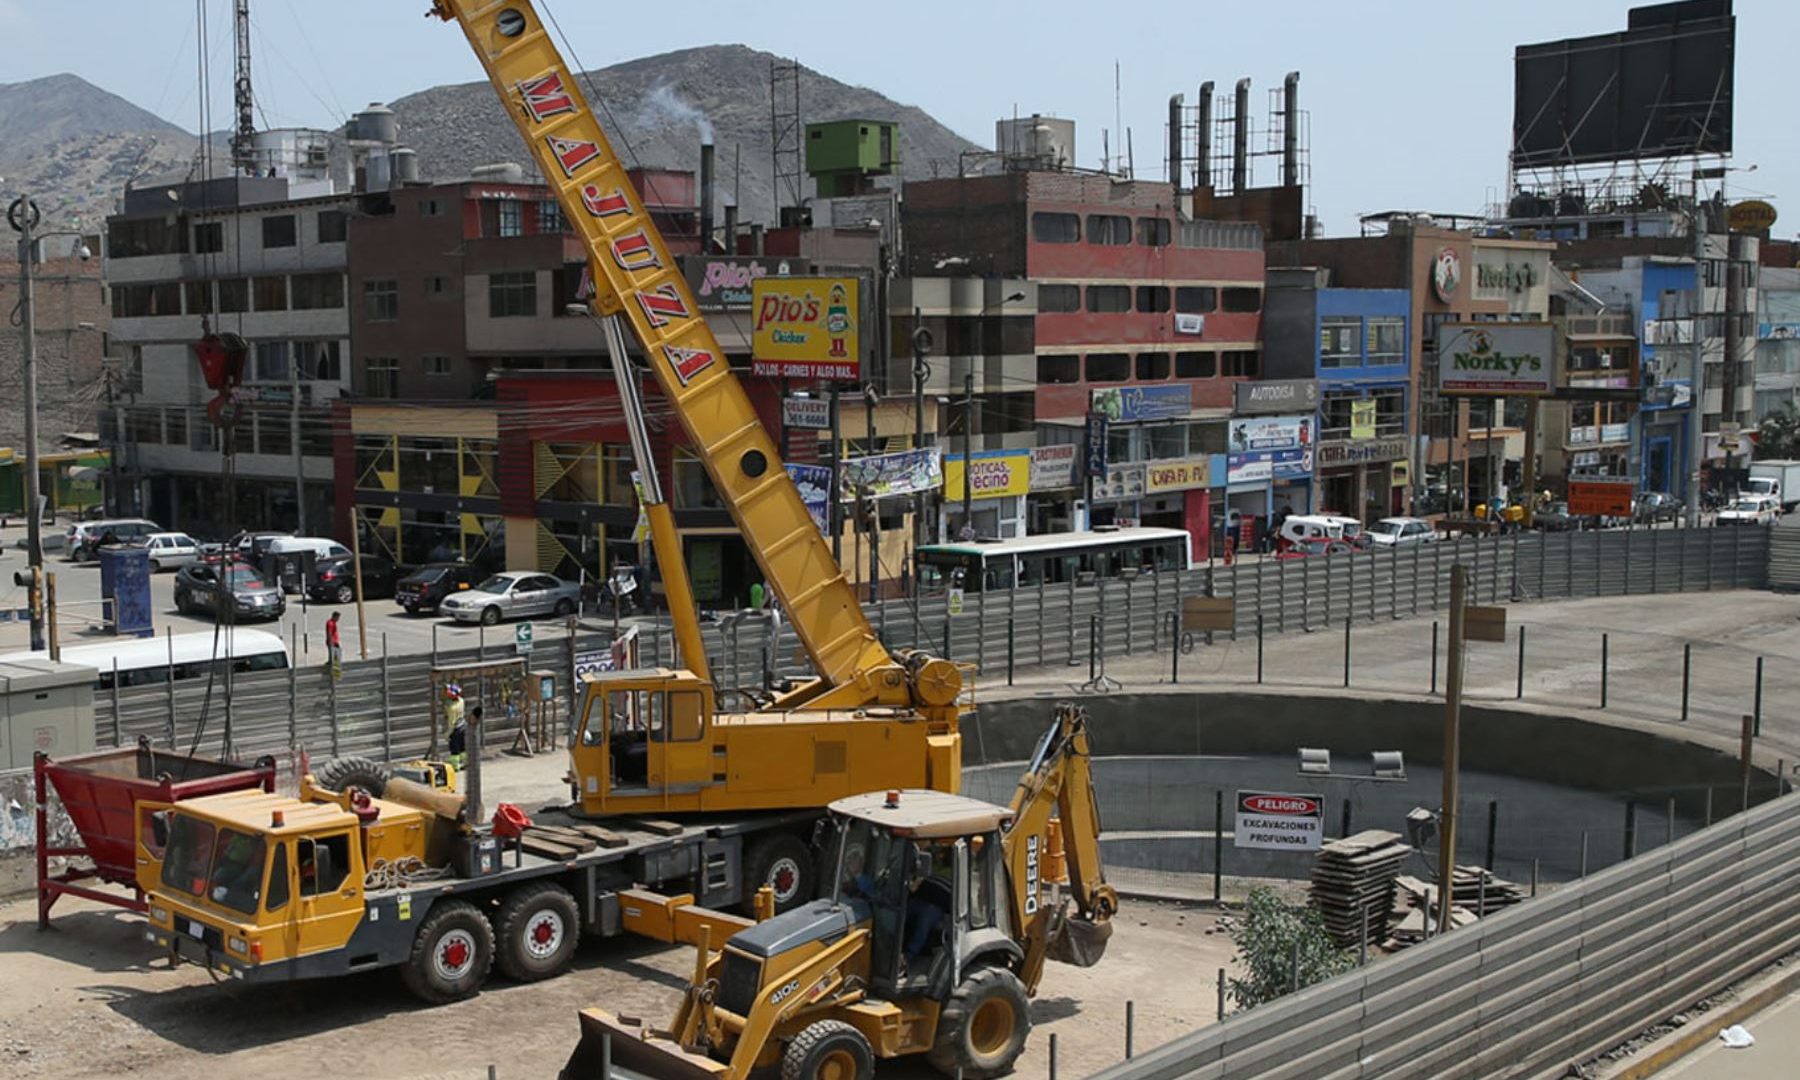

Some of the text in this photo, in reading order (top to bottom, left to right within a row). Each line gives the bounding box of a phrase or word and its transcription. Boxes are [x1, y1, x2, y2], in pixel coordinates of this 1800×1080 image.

[516, 69, 715, 387] MAJUZA
[1453, 351, 1542, 376] Norky's
[970, 462, 1006, 475] OTICAS
[970, 474, 1010, 489] ecino
[1256, 799, 1308, 811] PELIGRO
[1242, 818, 1317, 831] EXCAVACIONES
[1249, 833, 1308, 845] PROFUNDAS
[1025, 834, 1038, 914] DEERE
